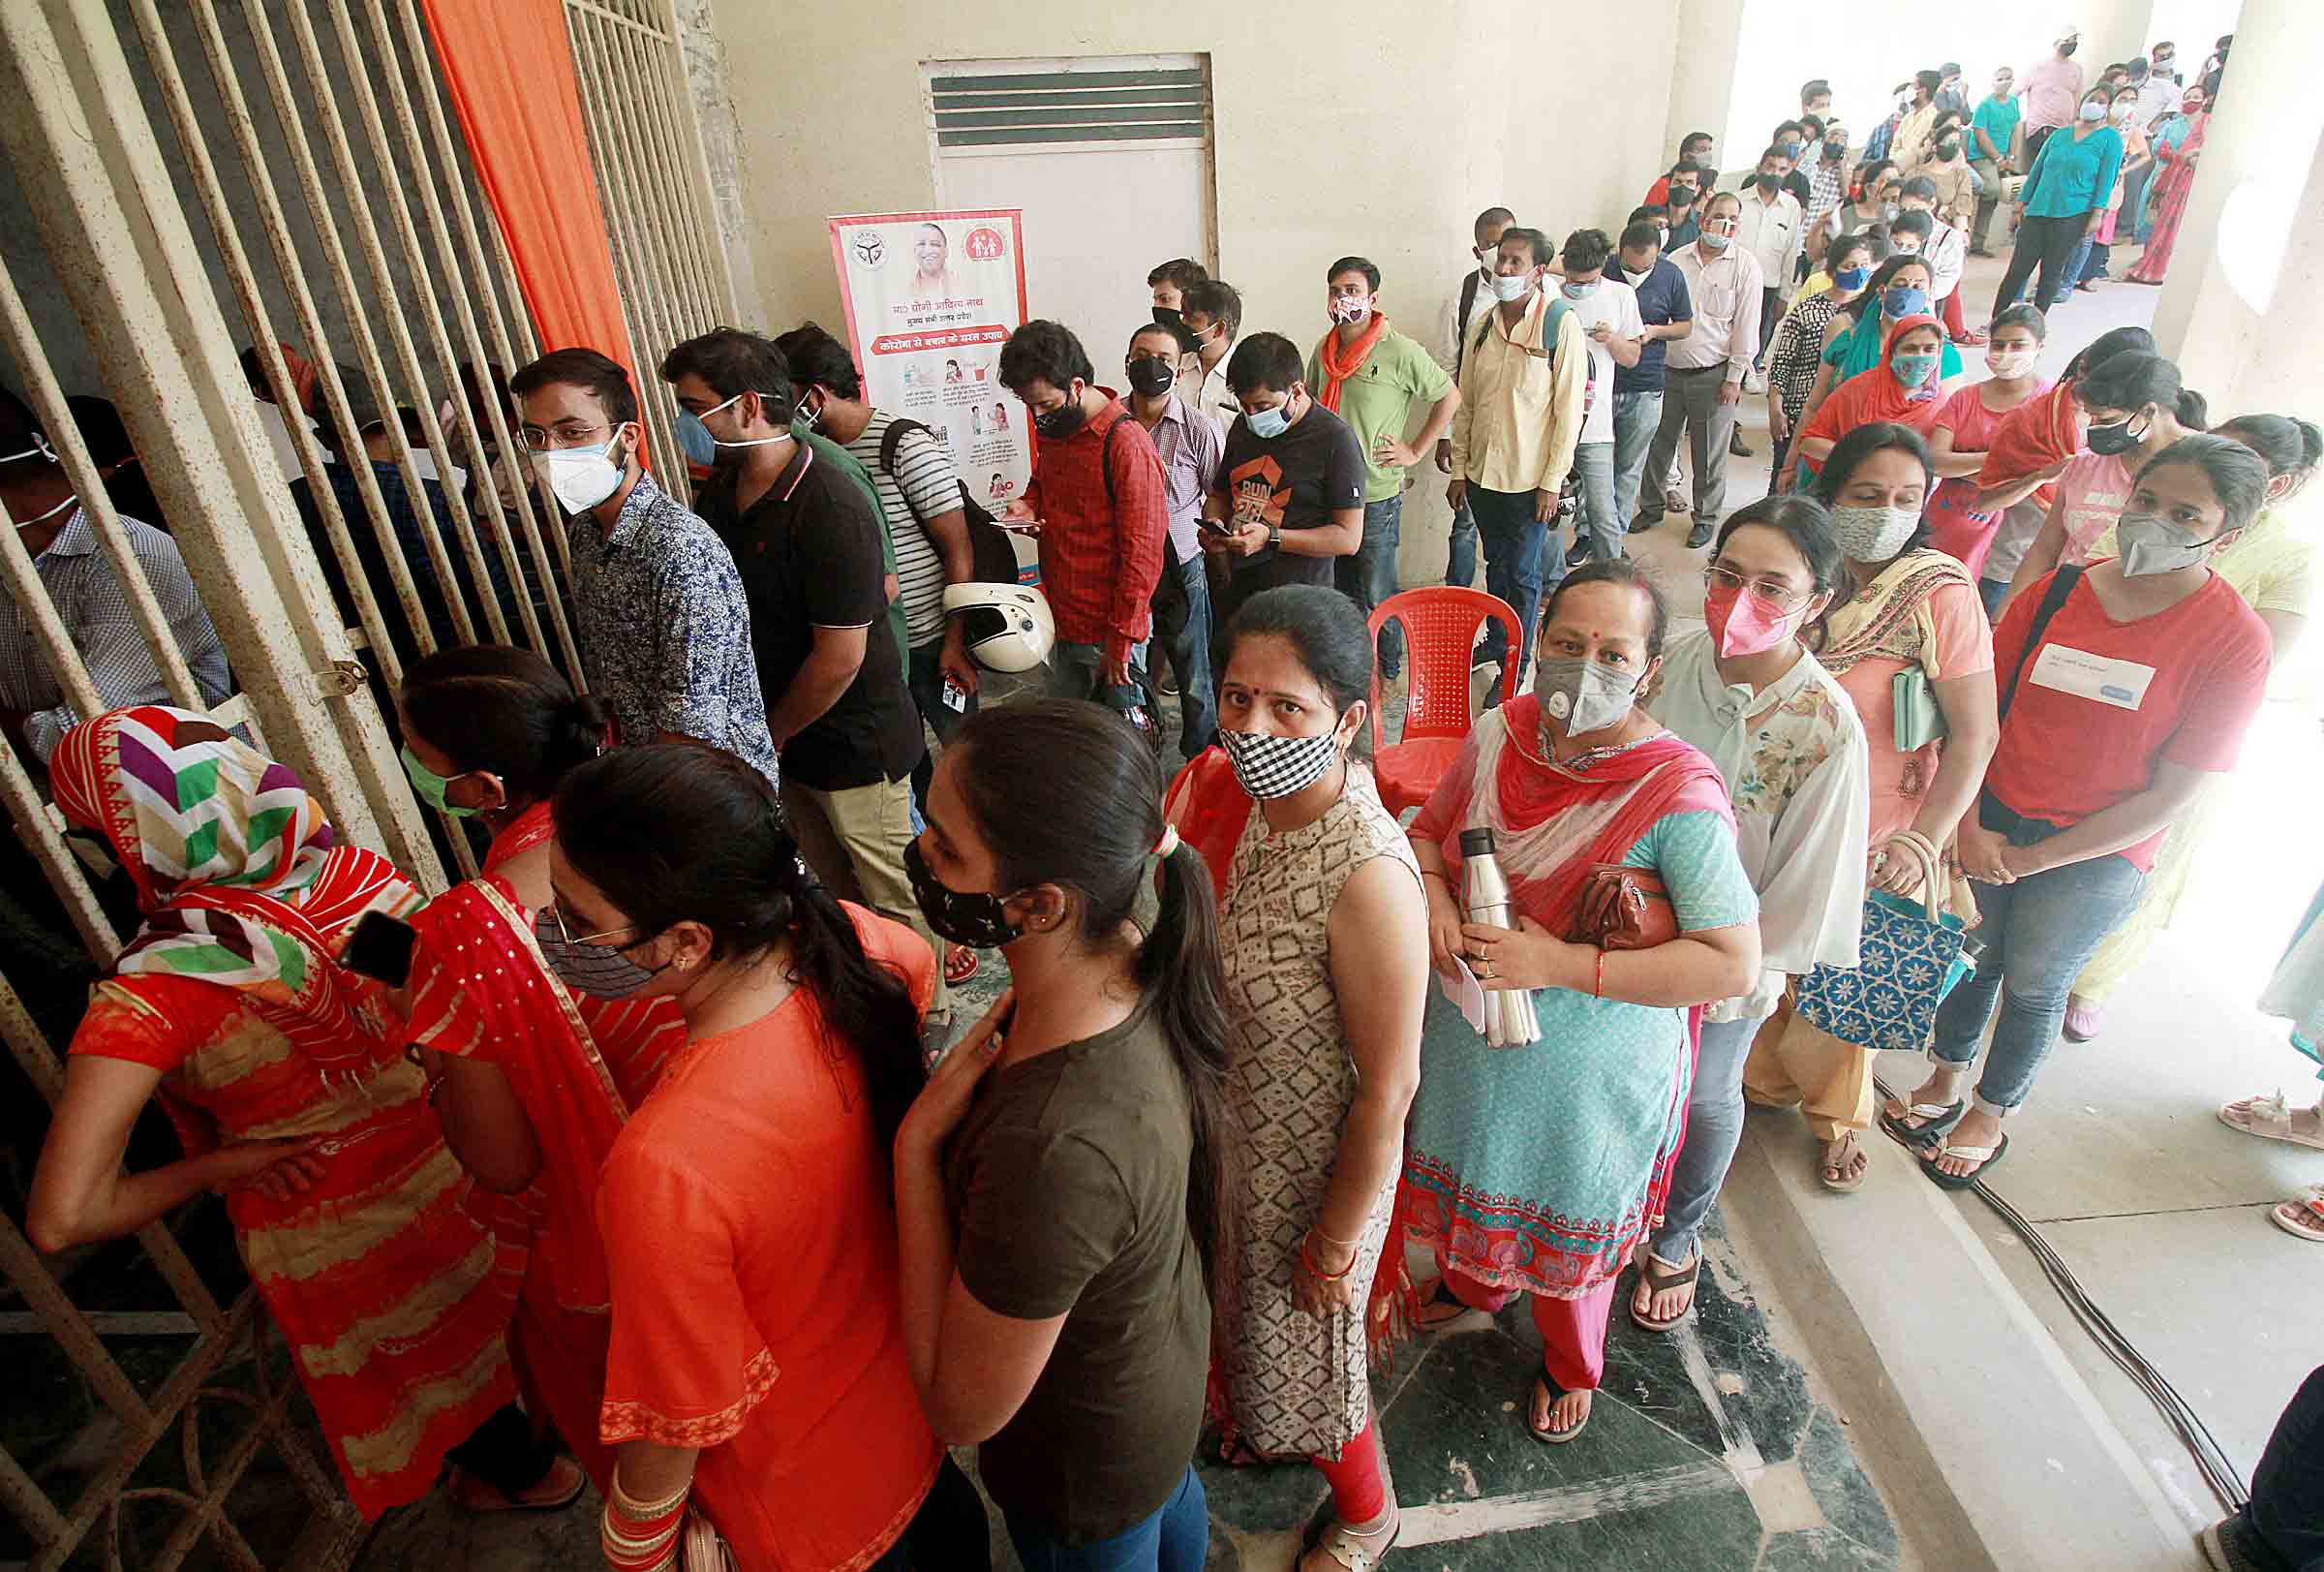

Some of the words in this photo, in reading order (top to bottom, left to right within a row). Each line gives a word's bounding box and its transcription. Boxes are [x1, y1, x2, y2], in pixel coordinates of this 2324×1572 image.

[911, 300, 932, 312] योगी
[913, 336, 922, 348] से
[982, 330, 1004, 341] उपाय
[1242, 479, 1271, 498] RUN
